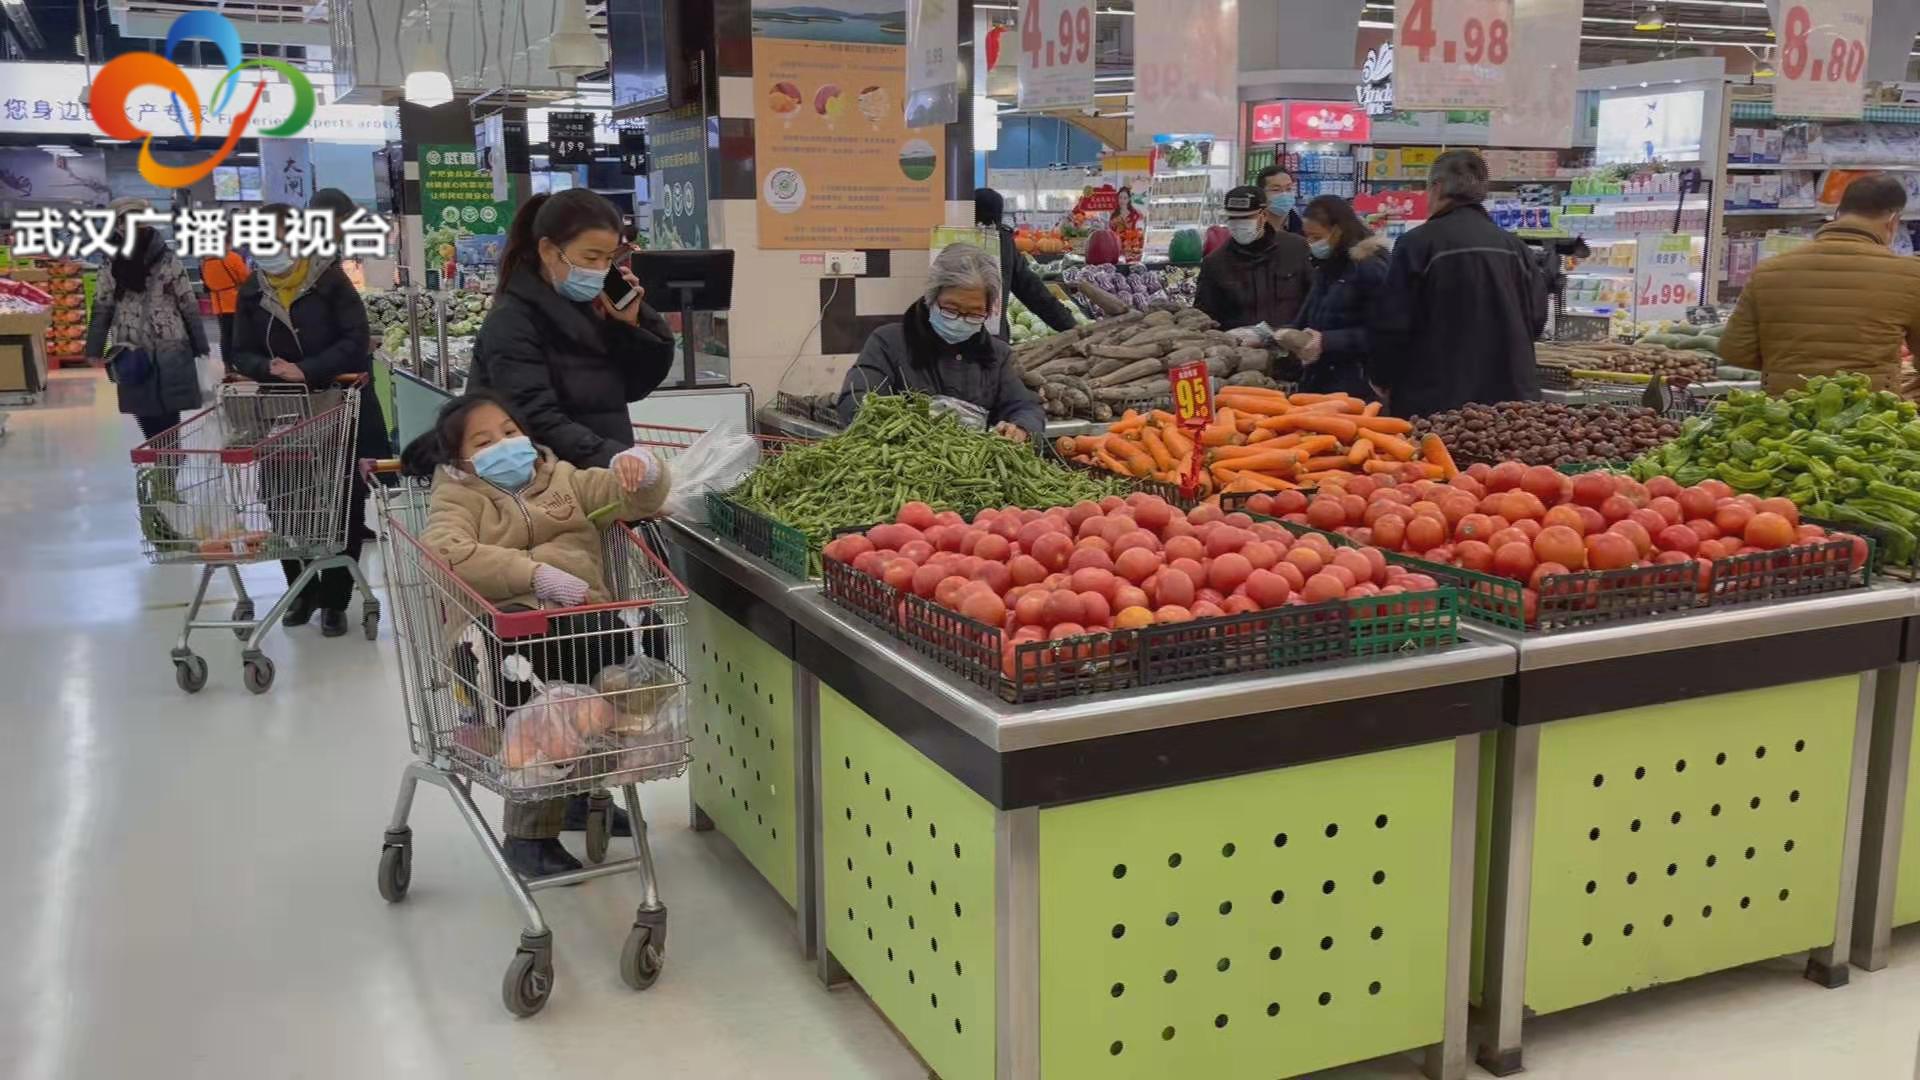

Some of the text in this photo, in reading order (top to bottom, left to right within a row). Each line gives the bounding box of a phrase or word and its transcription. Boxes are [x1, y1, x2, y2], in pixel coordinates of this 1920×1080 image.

[1022, 0, 1090, 68] 4.99
[1401, 0, 1508, 64] 4.98
[1782, 6, 1865, 83] 8.80
[1355, 83, 1393, 104] Vind
